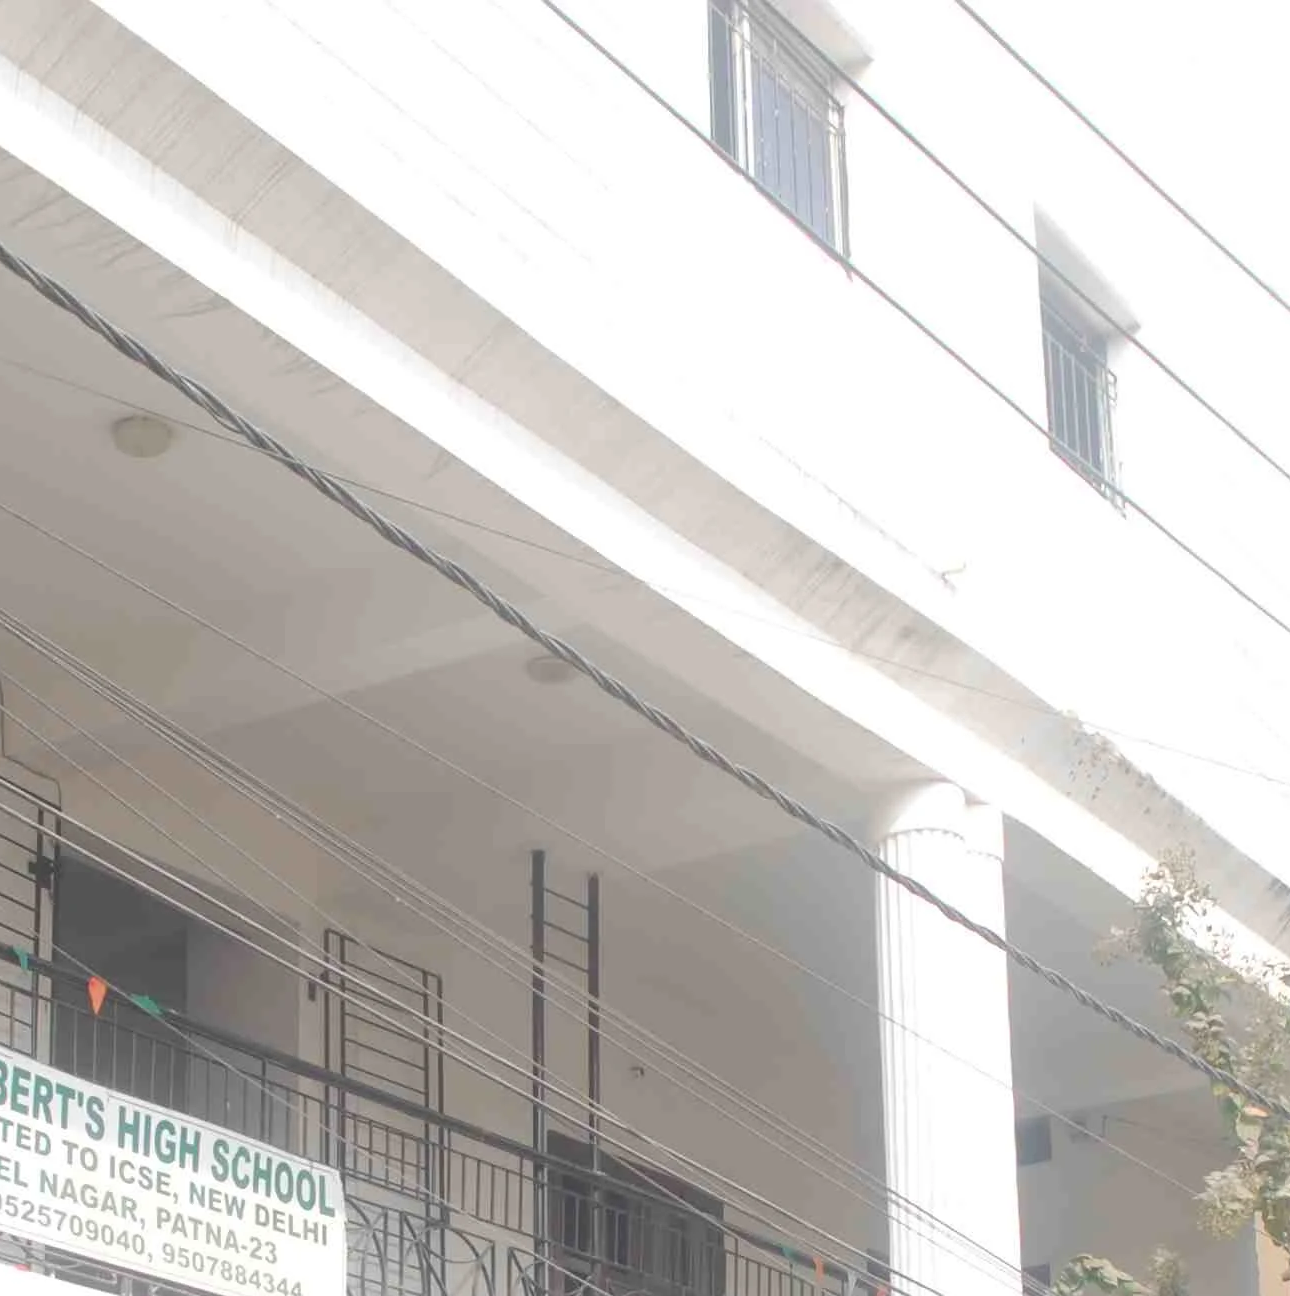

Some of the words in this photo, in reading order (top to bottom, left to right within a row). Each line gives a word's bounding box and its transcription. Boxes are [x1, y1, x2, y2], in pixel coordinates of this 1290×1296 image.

[62, 1140, 98, 1172] TO
[109, 1155, 179, 1204] ICSE,
[189, 1181, 246, 1221] NEW
[254, 1204, 328, 1246] DELHI
[118, 1106, 200, 1173] HIGH
[211, 1139, 336, 1218] SCHOOL
[40, 1169, 146, 1230] NAGAR,
[156, 1207, 278, 1264] PATNA-23
